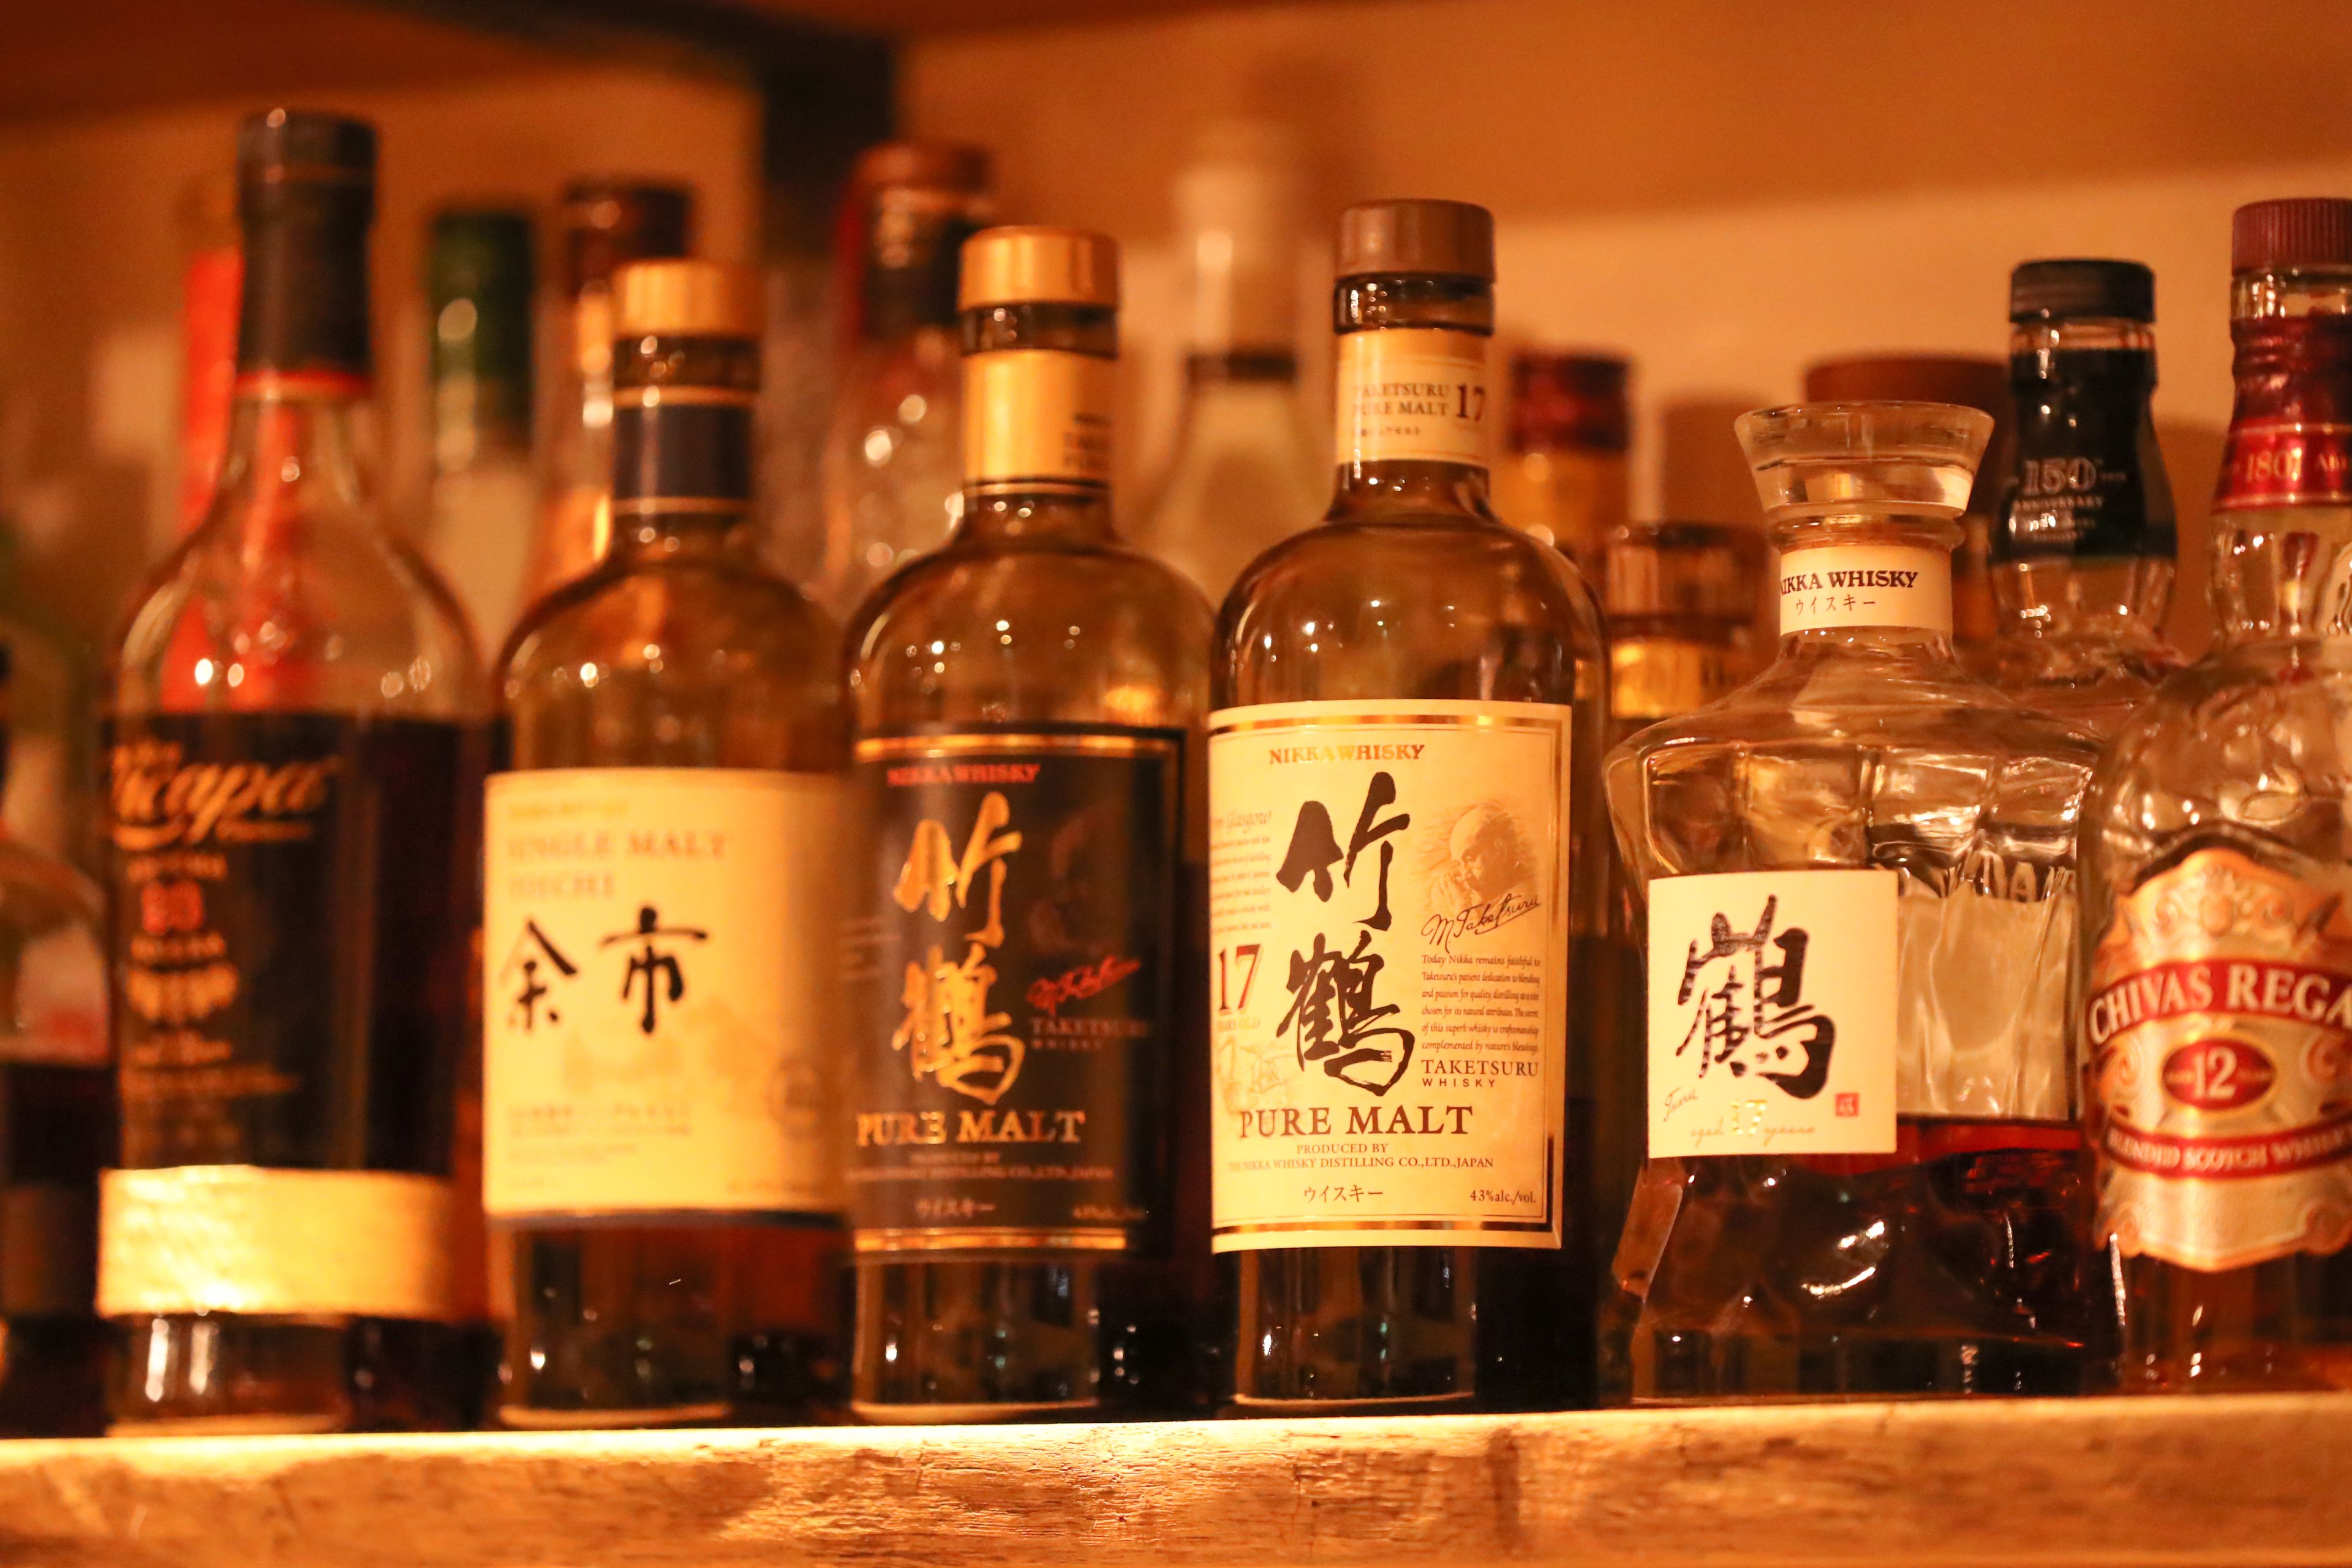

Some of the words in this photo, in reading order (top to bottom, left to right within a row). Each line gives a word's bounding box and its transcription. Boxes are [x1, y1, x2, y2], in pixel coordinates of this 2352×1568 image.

[1398, 401, 1449, 416] MALT
[1457, 383, 1487, 421] 17
[1827, 570, 1919, 589] WHISKY
[1795, 594, 1877, 616] ウイスキー
[1453, 893, 1541, 938] Taketsuru
[1276, 772, 1415, 1097] 竹鶴
[892, 791, 1025, 1106] 竹鶴
[496, 905, 710, 1035] 余市
[1422, 954, 1446, 967] Today
[1449, 954, 1472, 964] Nikka
[1476, 957, 1504, 965] remains
[1506, 954, 1532, 969] faithful
[1534, 958, 1541, 967] to
[1218, 943, 1263, 1014] 17
[1422, 971, 1457, 981] Taketsuru's
[1459, 974, 1480, 984] patient
[1482, 971, 1511, 982] dedication
[1422, 988, 1434, 998] and
[1435, 989, 1458, 1001] passion
[1459, 988, 1469, 1002] for
[1676, 894, 1836, 1099] 鶴
[2089, 963, 2213, 1045] CHIVAS
[1422, 1005, 1442, 1016] chosen
[1443, 1005, 1453, 1019] for
[1463, 1006, 1485, 1016] natural
[1422, 1022, 1430, 1036] of
[1430, 1022, 1444, 1033] this
[1446, 1022, 1467, 1036] superb
[1468, 1023, 1491, 1037] whisky
[1493, 1023, 1499, 1033] is
[1422, 1039, 1473, 1053] complemented
[1475, 1039, 1484, 1054] by
[1421, 1060, 1539, 1077] TAKETSURU
[2193, 1046, 2237, 1099] 12
[1422, 1078, 1496, 1088] WHISKY
[858, 1110, 946, 1147] PURE
[956, 1108, 1086, 1143] MALT
[1238, 1107, 1332, 1139] PURE
[1345, 1104, 1473, 1134] MALT
[1297, 1144, 1367, 1155] PRODUCED
[1372, 1143, 1389, 1153] BY
[1272, 1158, 1316, 1169] WHISKY
[1321, 1156, 1394, 1168] DISTILLING
[1304, 1185, 1384, 1203] ウイスキー
